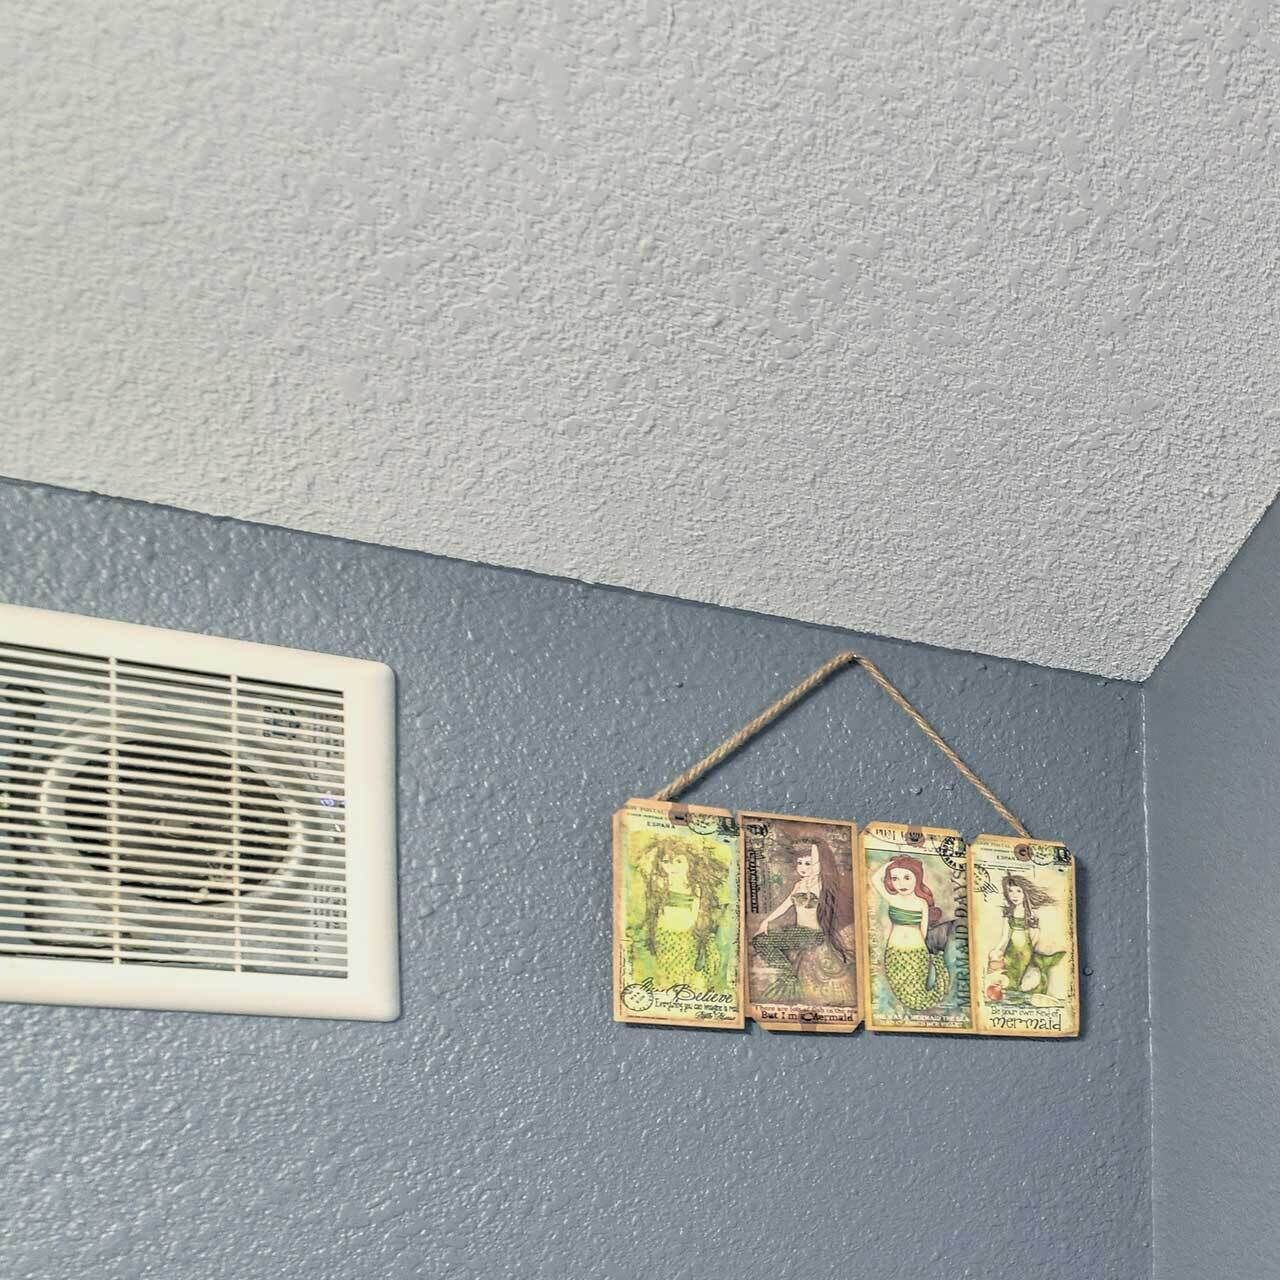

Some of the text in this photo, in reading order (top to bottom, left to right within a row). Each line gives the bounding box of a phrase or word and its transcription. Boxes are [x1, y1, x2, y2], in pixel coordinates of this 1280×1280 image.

[950, 869, 968, 919] DAYS
[954, 924, 971, 1008] MERMAID
[667, 983, 733, 1004] Believe
[761, 1011, 777, 1019] But
[991, 1006, 1000, 1014] Be
[1002, 1009, 1017, 1017] your
[989, 1013, 1061, 1031] mermaid
